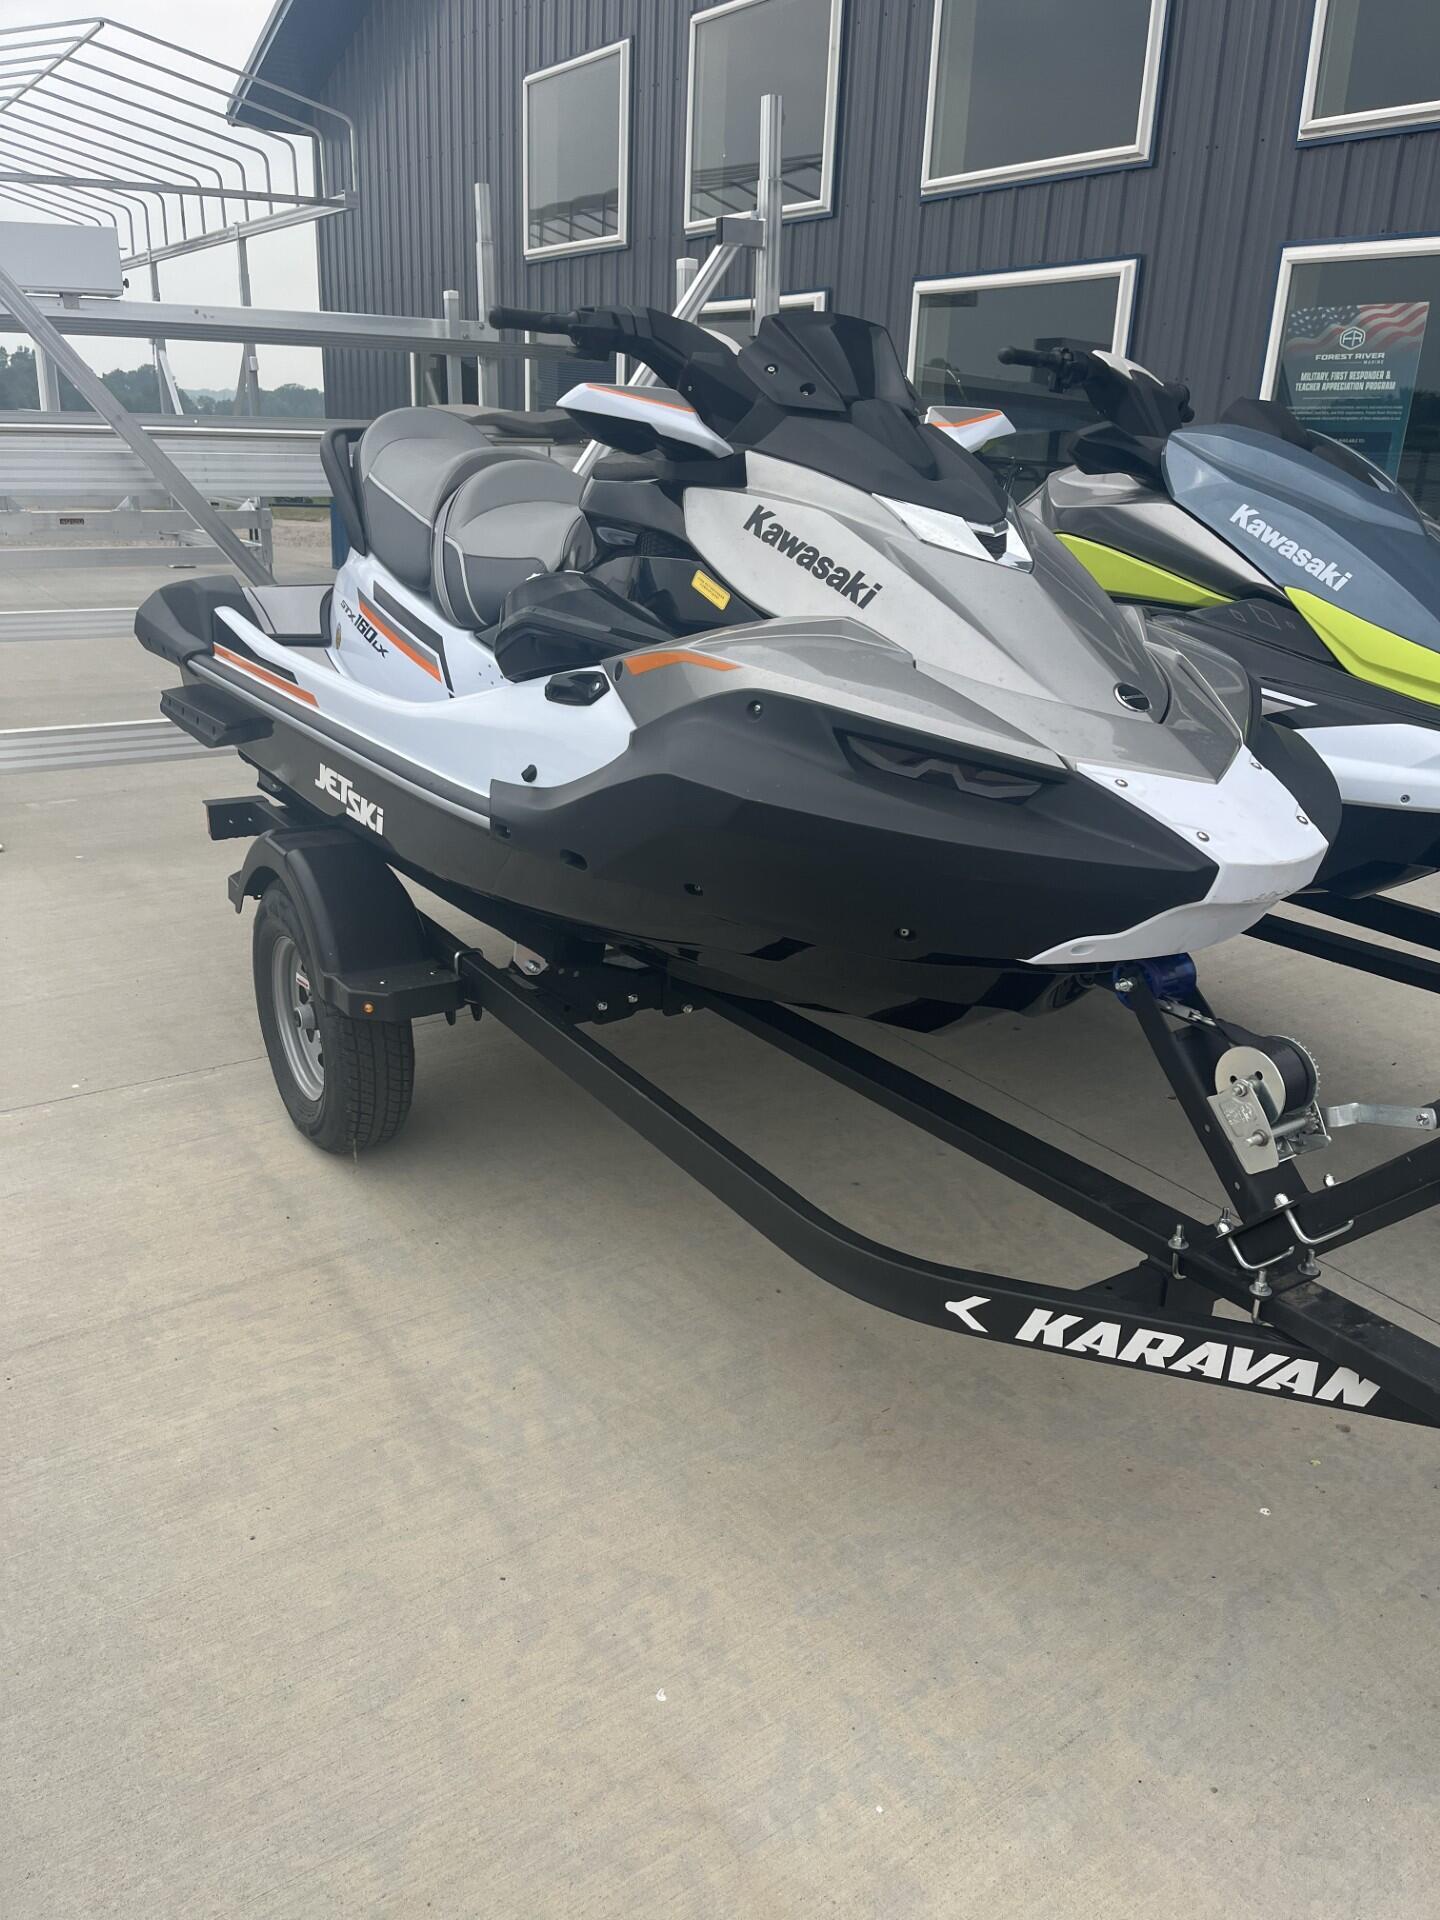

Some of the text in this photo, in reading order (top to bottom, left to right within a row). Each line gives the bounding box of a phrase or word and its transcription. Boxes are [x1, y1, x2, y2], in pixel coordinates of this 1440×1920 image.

[1300, 371, 1329, 382] MILITARY,
[1330, 371, 1348, 381] FIRST
[1349, 370, 1384, 380] RESPONDER
[1355, 352, 1385, 360] RIVER
[1295, 381, 1396, 391] TEACHER APPRECIATION PROGRAM
[743, 504, 883, 610] Kawasaki
[1229, 503, 1353, 592] Kawasaki
[1015, 1308, 1381, 1407] KARAVAN
